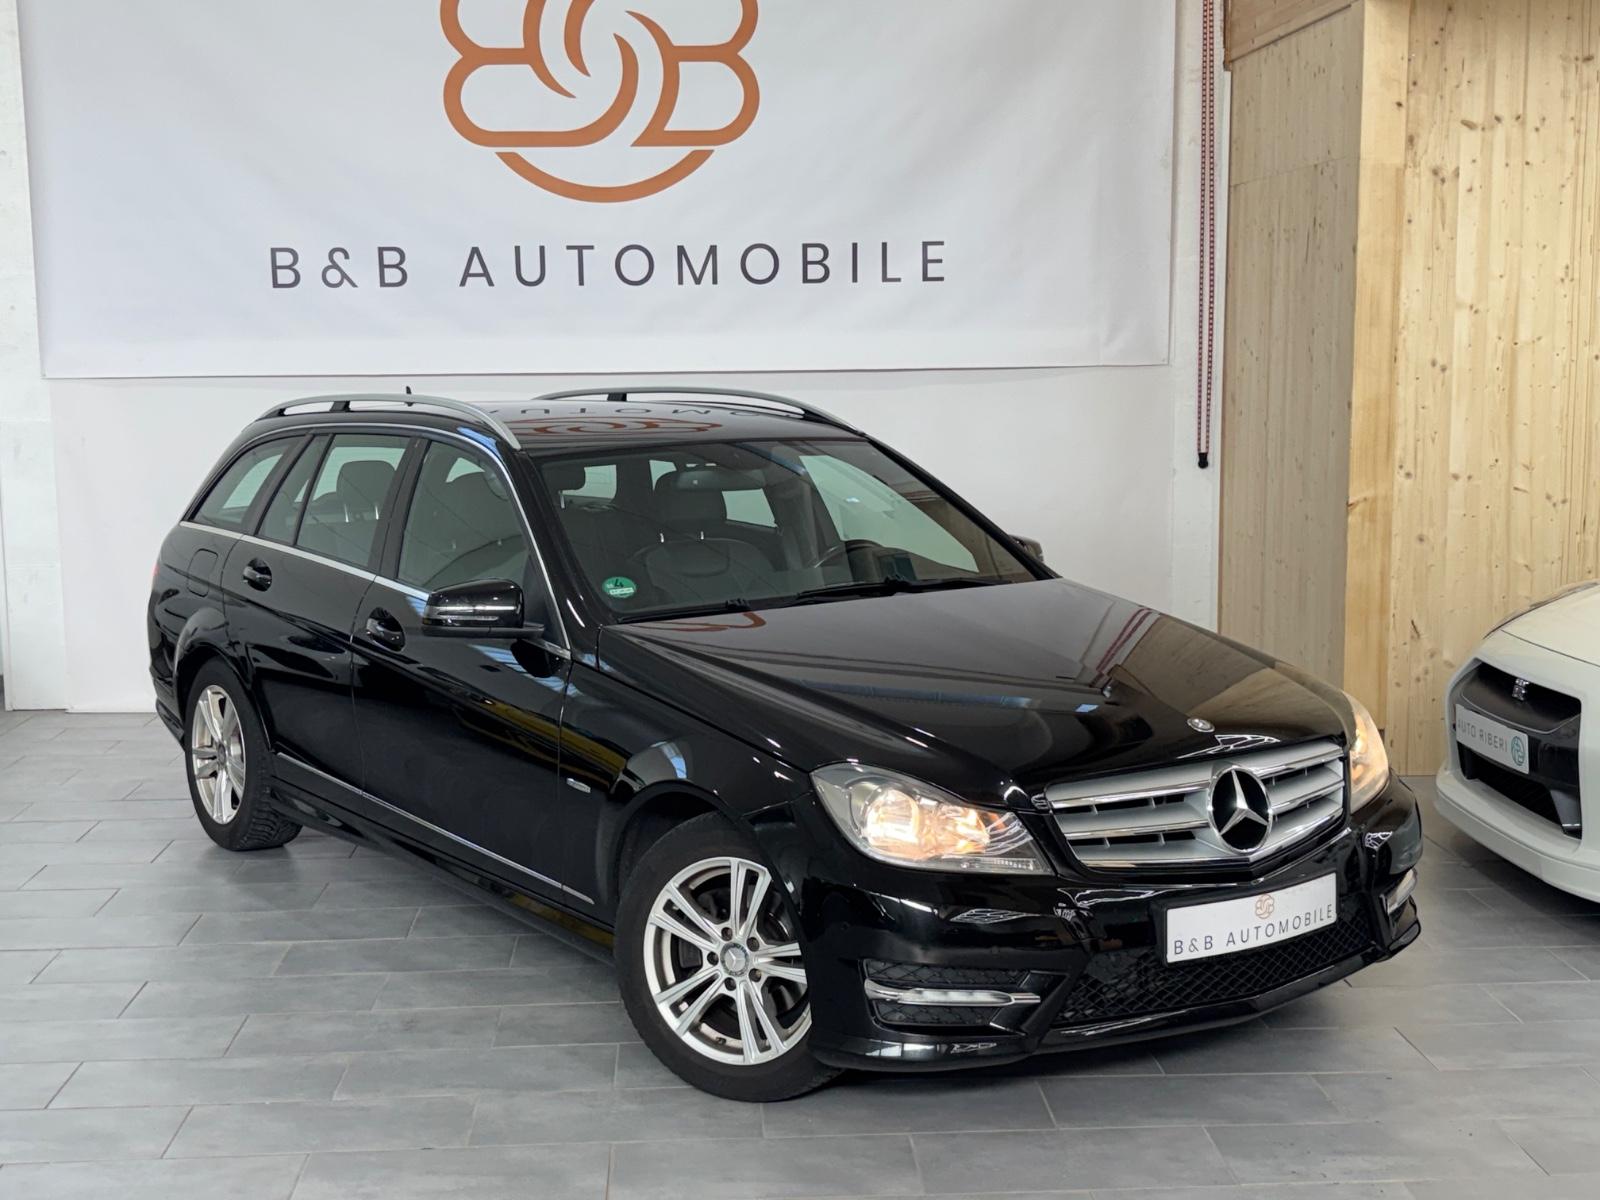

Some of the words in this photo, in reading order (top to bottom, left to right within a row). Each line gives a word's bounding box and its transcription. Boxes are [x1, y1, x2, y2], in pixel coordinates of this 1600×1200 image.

[270, 246, 409, 289] B&B
[458, 240, 945, 288] AUTOMOBILE
[1174, 935, 1213, 955] B&B
[1225, 903, 1333, 947] AUTOMOBILE
